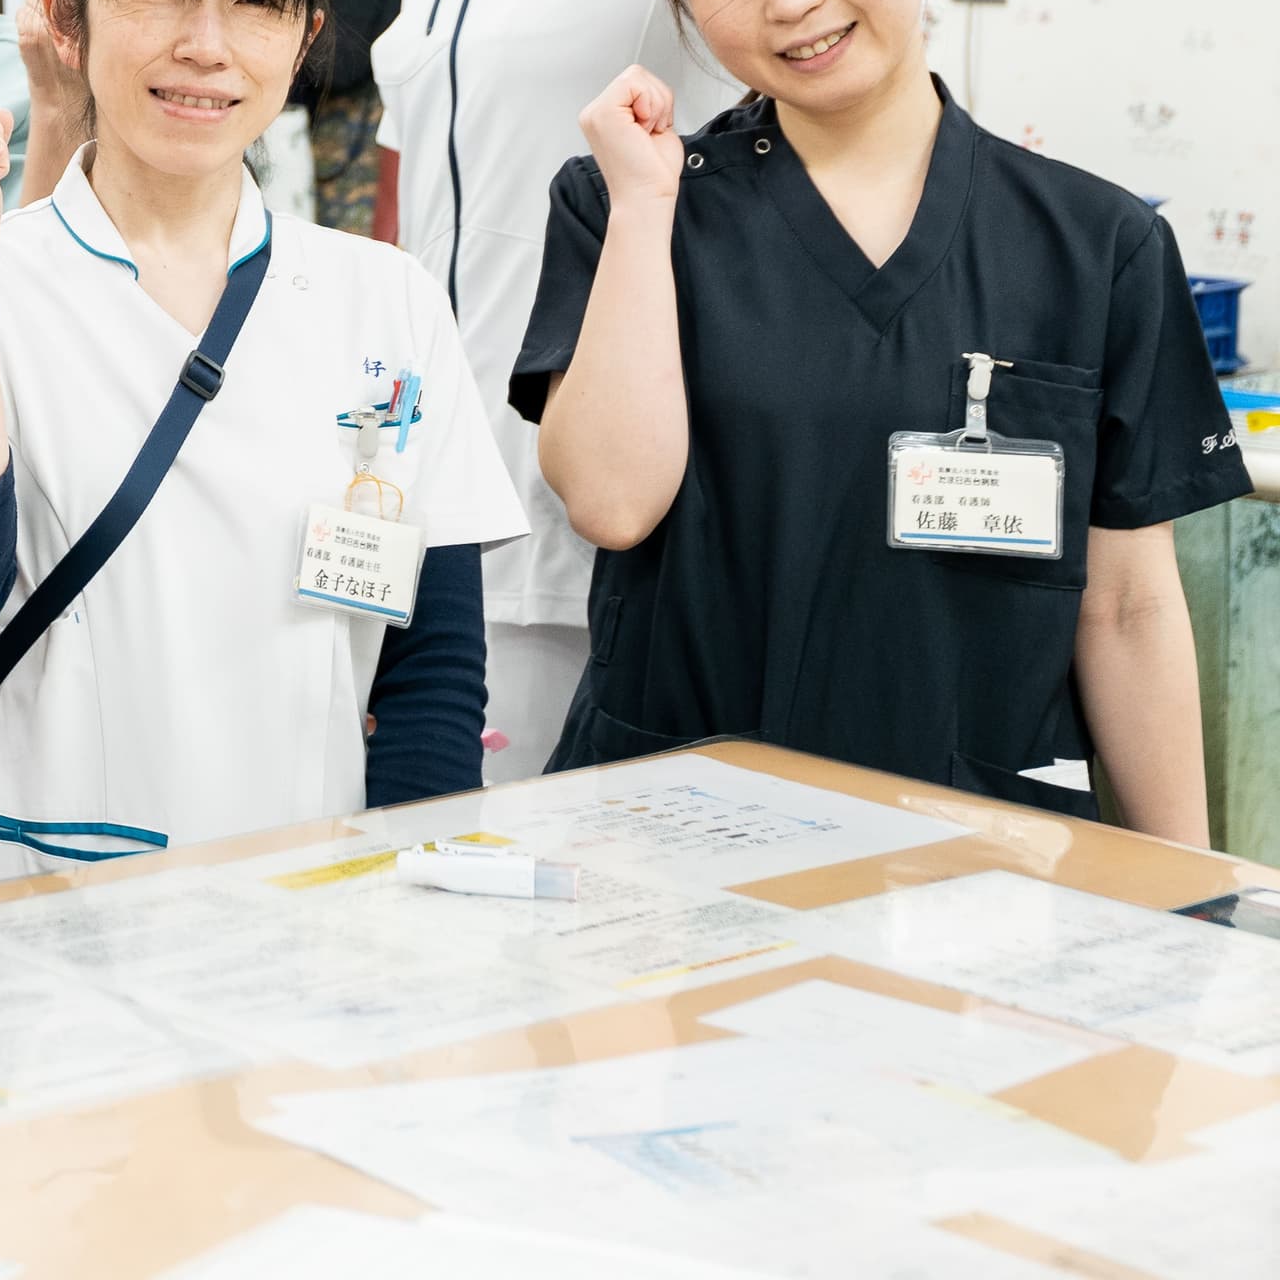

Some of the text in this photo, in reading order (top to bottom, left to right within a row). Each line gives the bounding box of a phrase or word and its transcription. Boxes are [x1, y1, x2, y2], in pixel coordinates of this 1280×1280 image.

[916, 510, 959, 531] 佐藤
[314, 569, 392, 602] 金子なほ子
